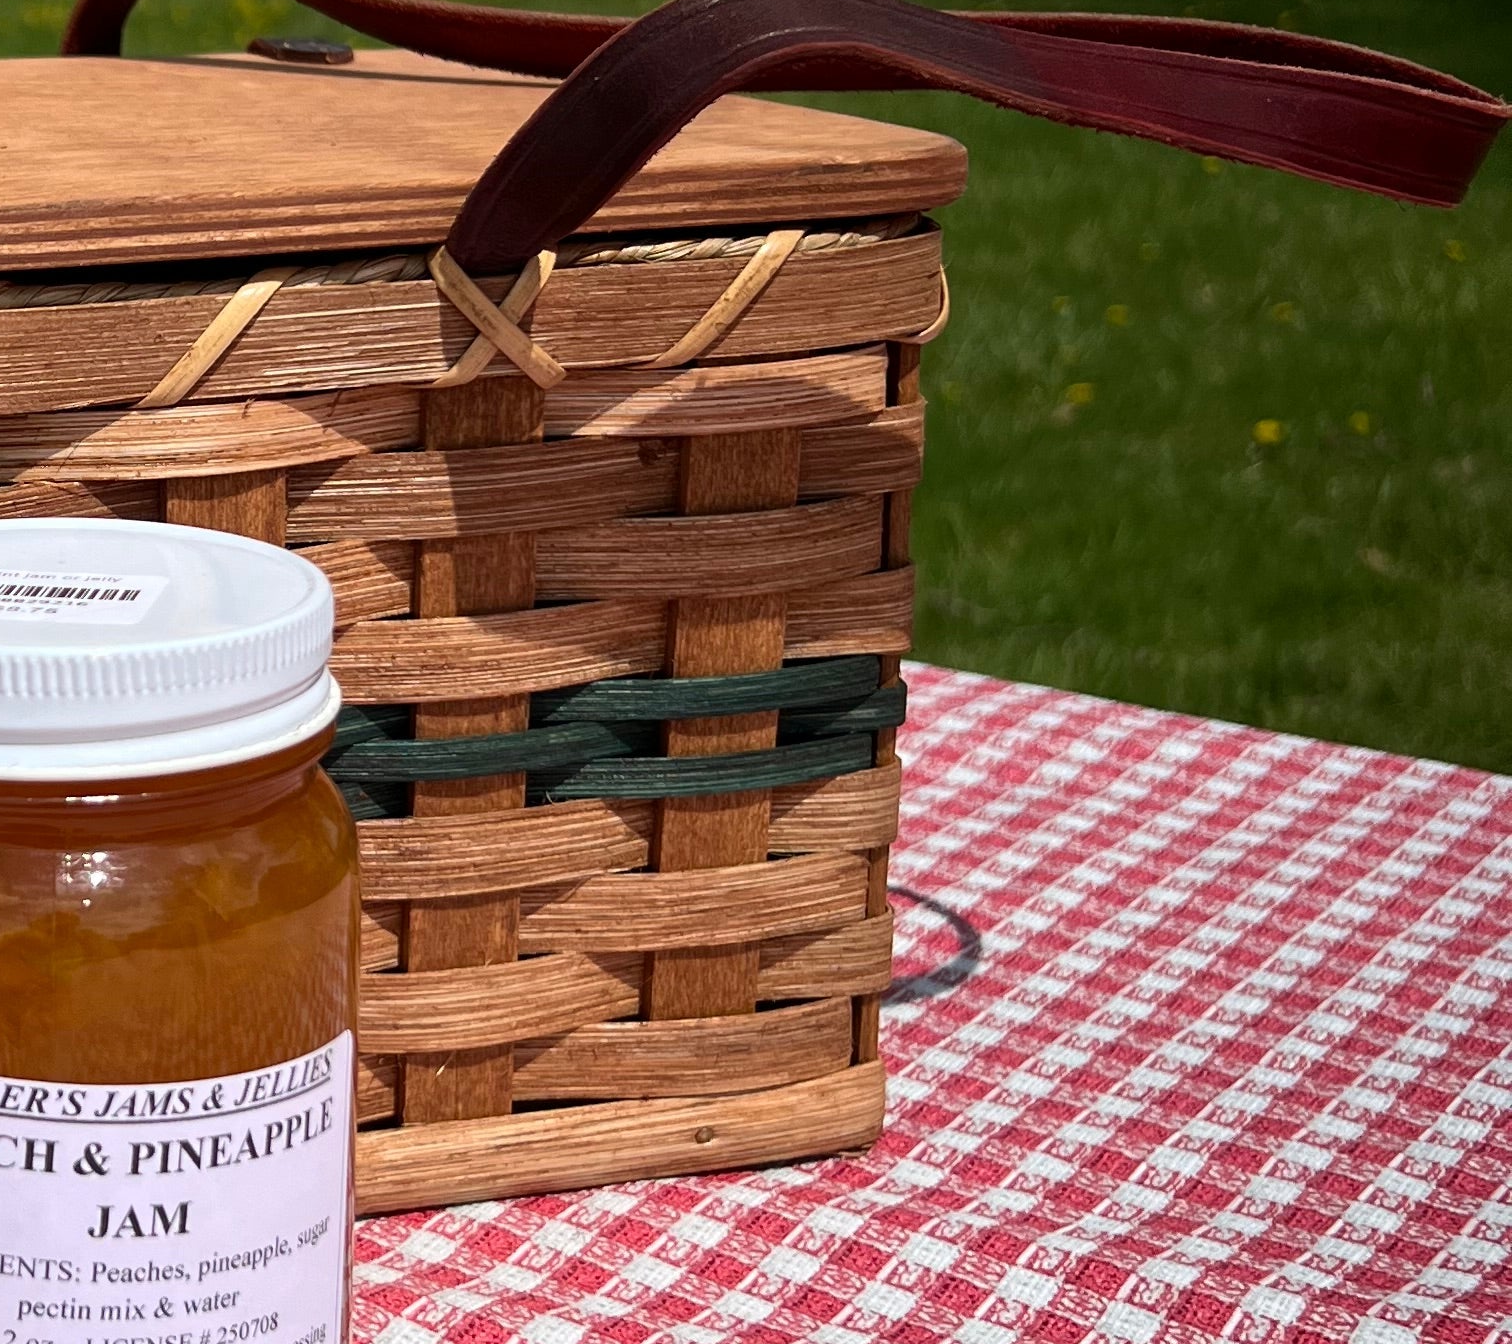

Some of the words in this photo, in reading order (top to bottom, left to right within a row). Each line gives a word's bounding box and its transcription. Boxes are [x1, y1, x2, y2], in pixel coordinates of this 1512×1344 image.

[23, 572, 57, 580] jam
[83, 575, 124, 583] jelly
[94, 1086, 194, 1118] JAMS
[201, 1082, 224, 1111] &
[234, 1047, 334, 1107] JELLIES
[72, 1141, 110, 1176] &
[128, 1095, 334, 1176] PINEAPPLE
[87, 1199, 192, 1239] JAM
[90, 1260, 191, 1283] Peaches,
[198, 1235, 293, 1282] pineapple,
[296, 1214, 331, 1248] sugar
[16, 1297, 92, 1322] pectin
[99, 1297, 146, 1322] mix
[153, 1296, 175, 1320] &
[183, 1289, 241, 1315] water
